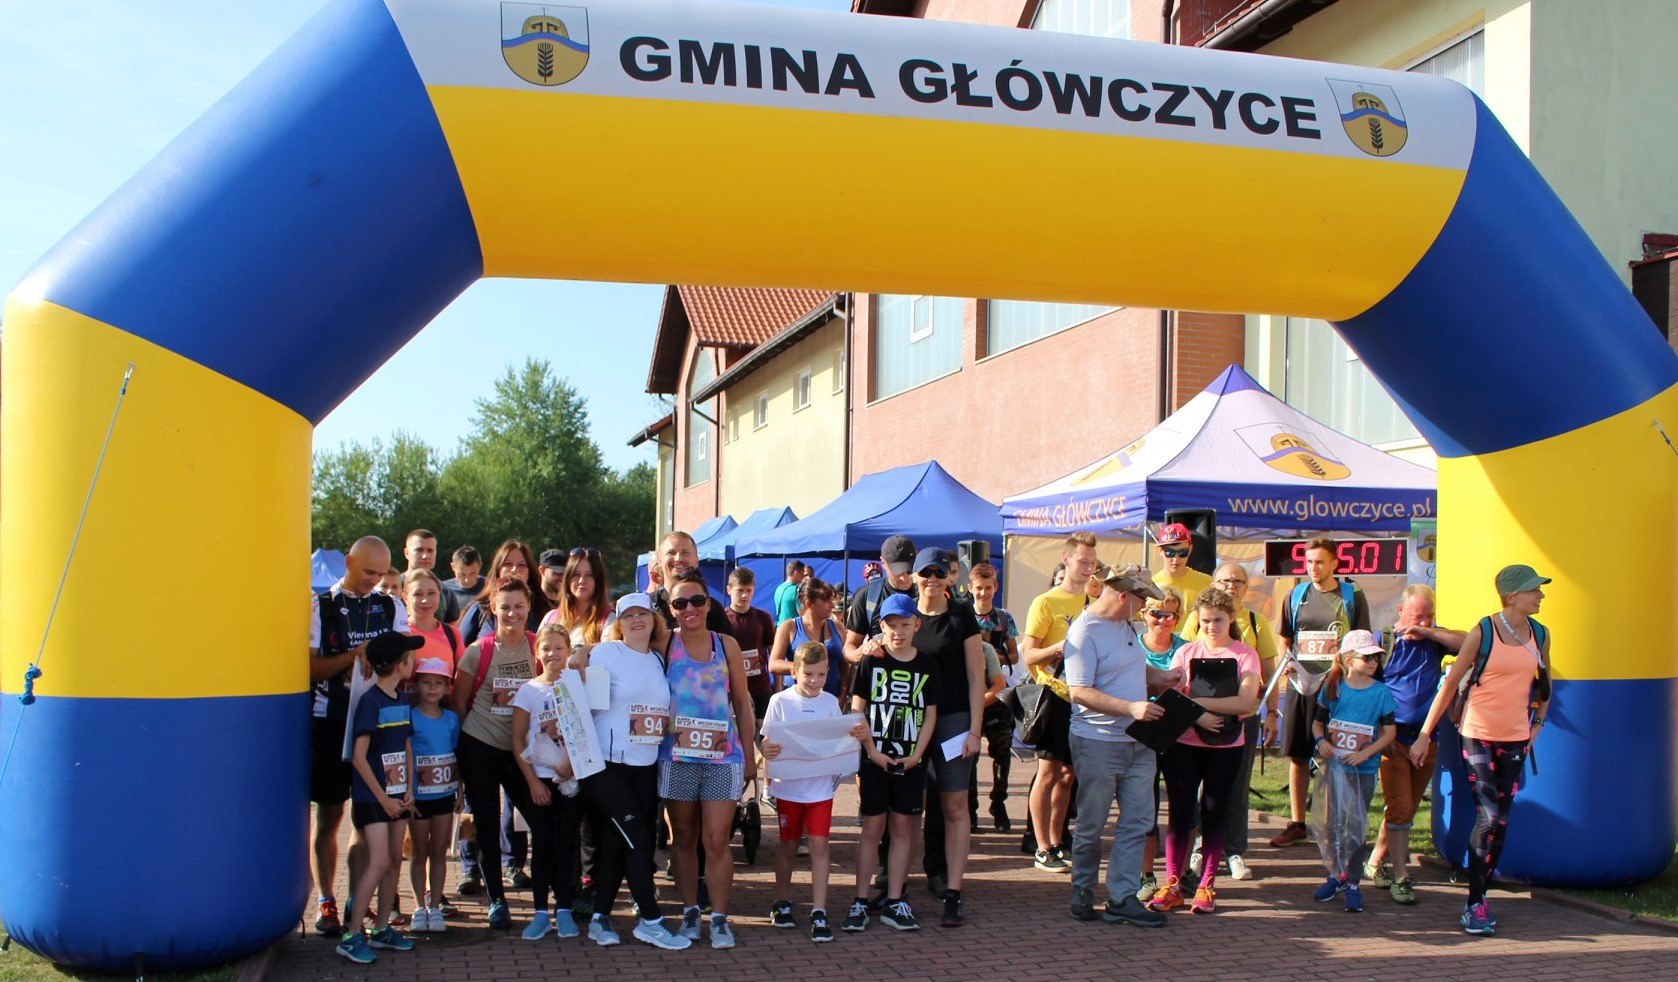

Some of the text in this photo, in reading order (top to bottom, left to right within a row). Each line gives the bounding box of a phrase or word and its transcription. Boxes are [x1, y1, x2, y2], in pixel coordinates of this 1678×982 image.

[619, 36, 1322, 140] GMINA GŁÓWCZYCE
[1053, 496, 1127, 528] GŁÓWCZYCE
[1227, 495, 1431, 522] www.glowczyce.pl
[1307, 640, 1326, 653] 87
[644, 717, 663, 734] 94
[689, 730, 713, 749] 95
[1336, 732, 1357, 750] 26
[432, 766, 451, 784] 30
